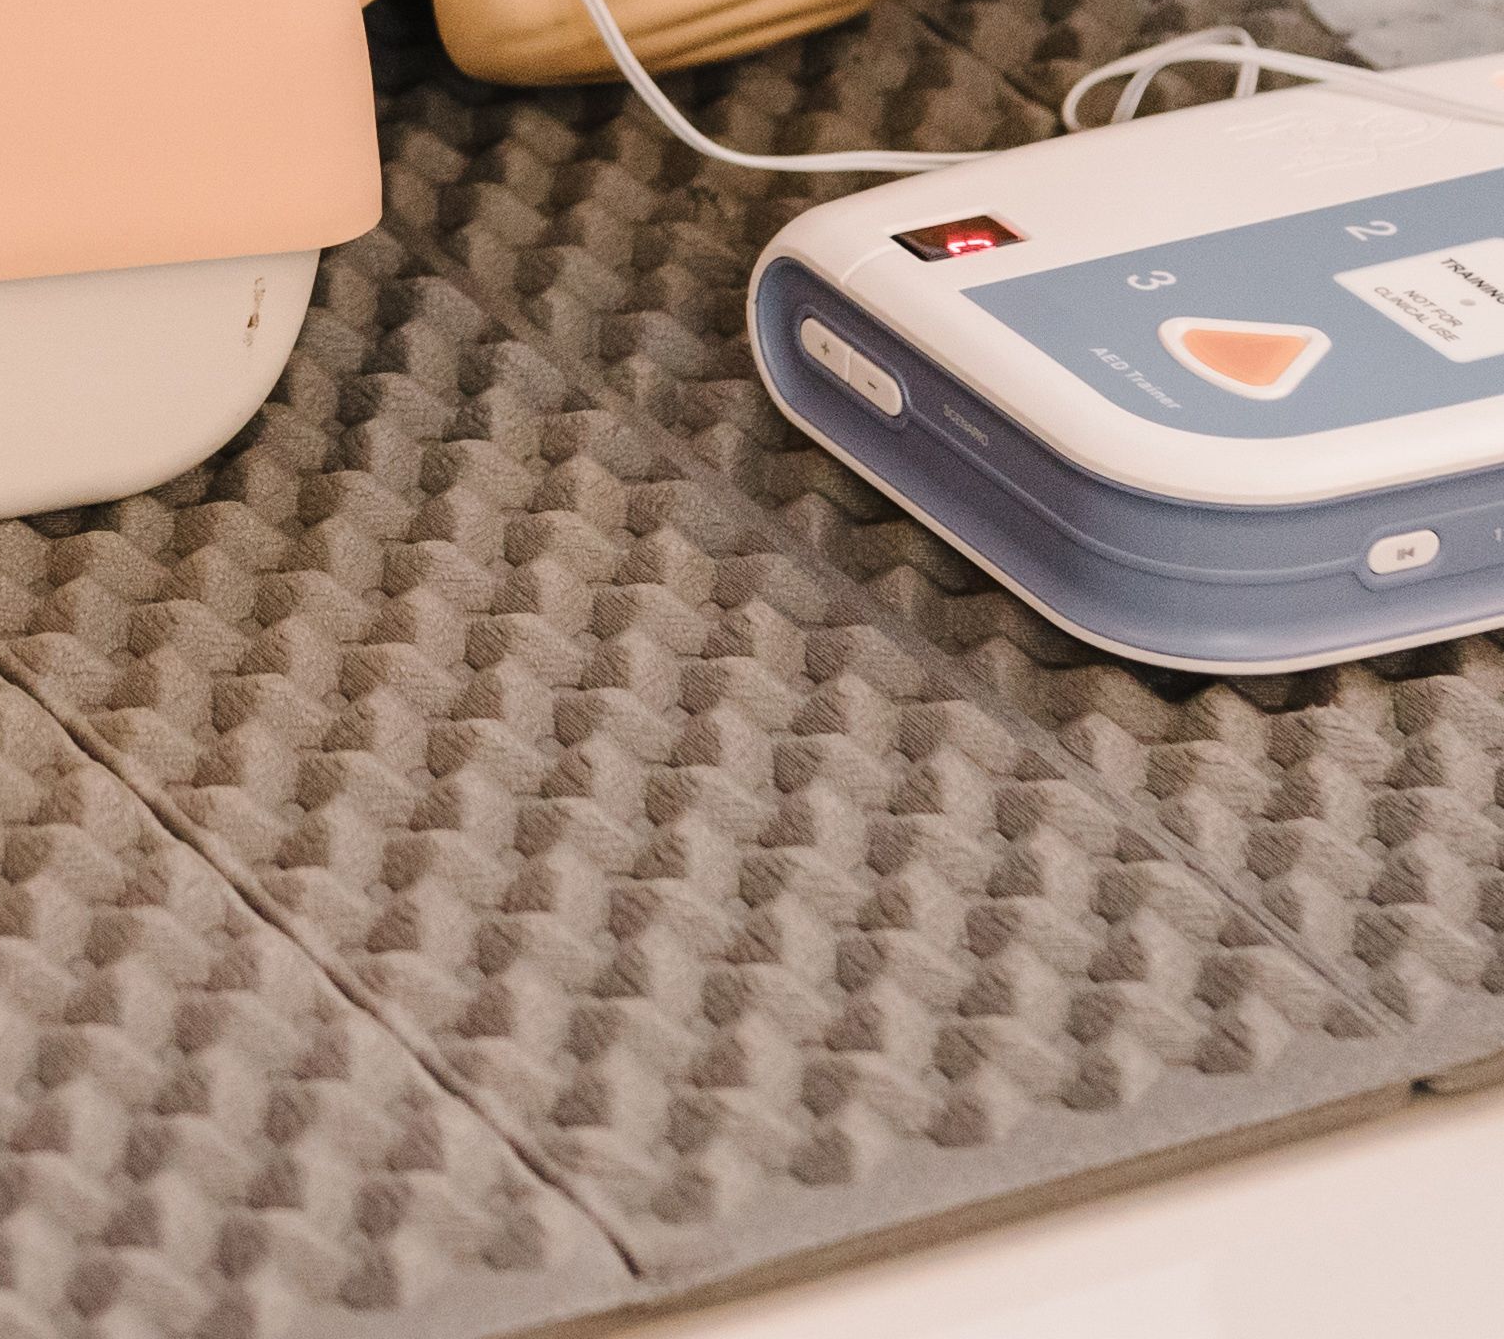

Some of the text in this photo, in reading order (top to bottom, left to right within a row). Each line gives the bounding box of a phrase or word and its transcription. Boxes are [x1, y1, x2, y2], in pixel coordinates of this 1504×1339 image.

[1345, 219, 1398, 242] 2
[1126, 269, 1178, 292] 3
[1374, 286, 1461, 342] CLINICAL USE
[1403, 289, 1463, 327] NOT FOR
[1089, 347, 1183, 409] AED Trainer
